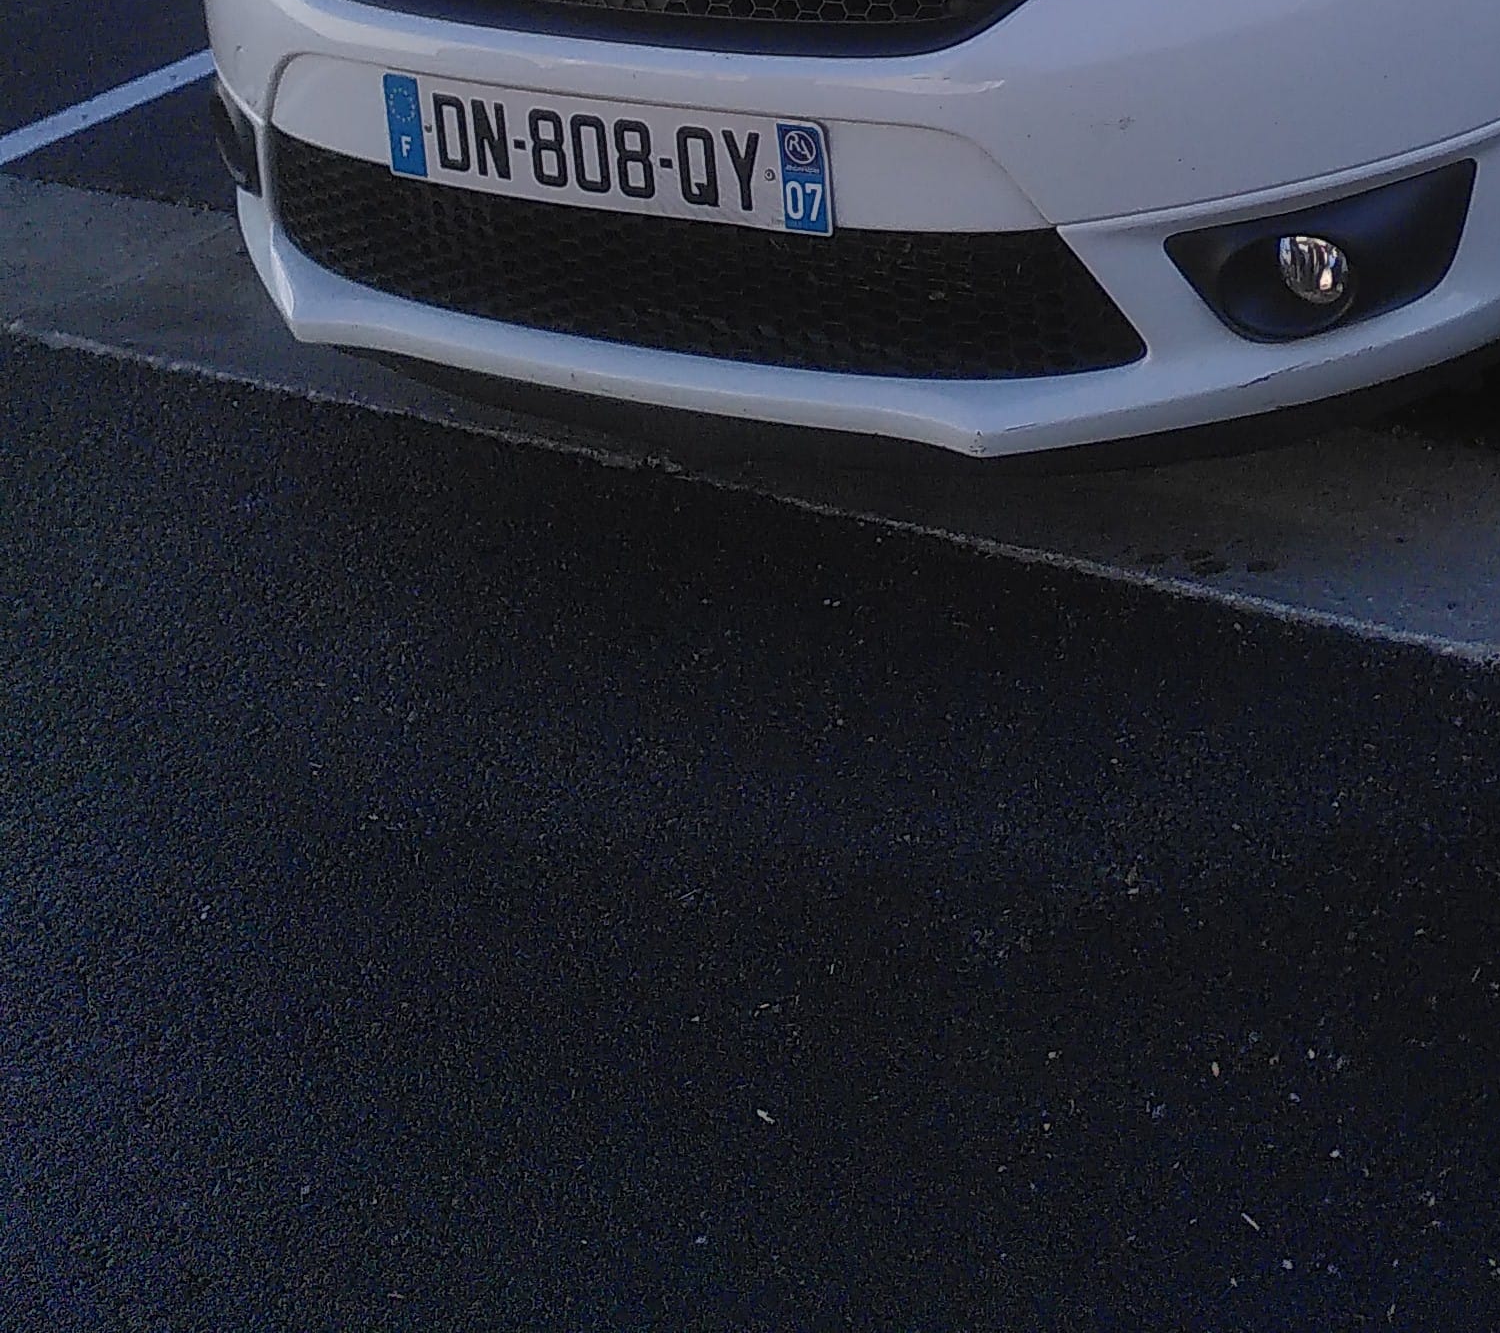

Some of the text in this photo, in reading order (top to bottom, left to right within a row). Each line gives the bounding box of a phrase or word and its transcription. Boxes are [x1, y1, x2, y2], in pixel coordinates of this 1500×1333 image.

[401, 136, 411, 157] F
[433, 92, 760, 210] DN-808-QY
[786, 180, 822, 221] 07
